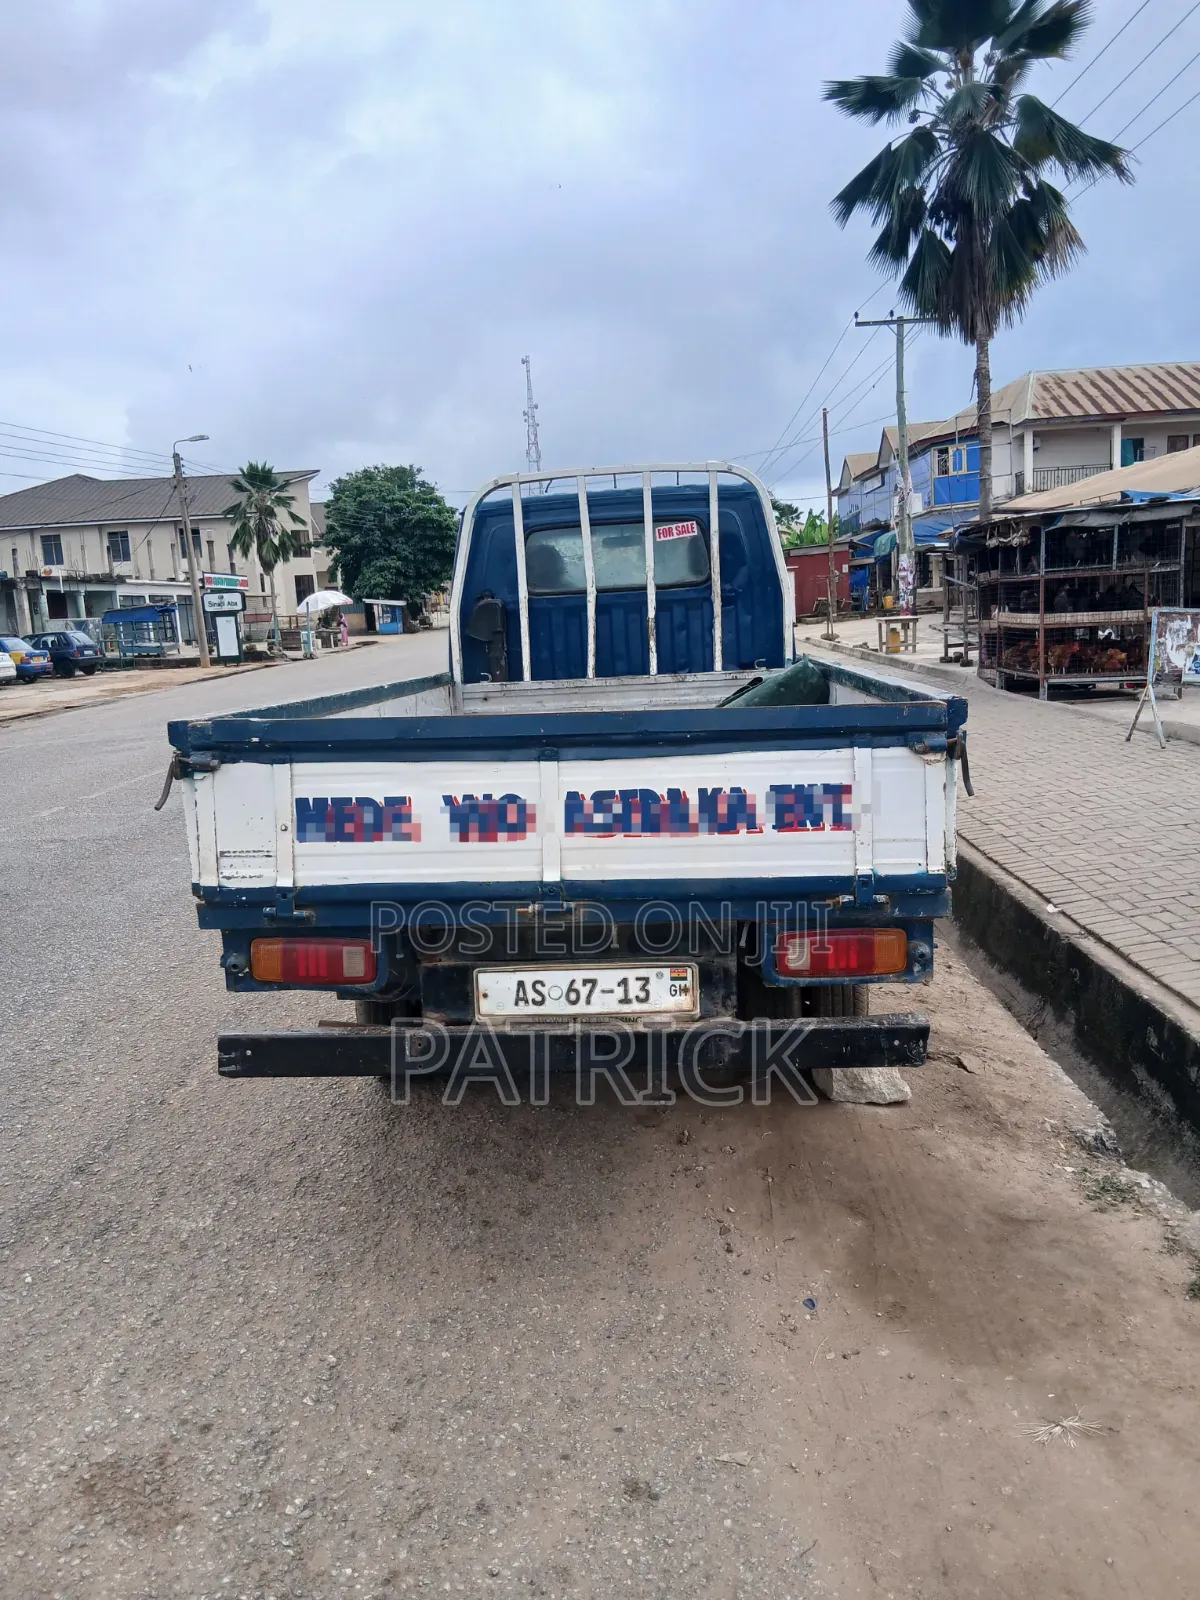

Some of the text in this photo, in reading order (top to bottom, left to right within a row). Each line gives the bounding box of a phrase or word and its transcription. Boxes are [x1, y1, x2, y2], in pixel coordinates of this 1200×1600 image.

[657, 523, 696, 539] FOR SALE
[514, 976, 651, 1007] AS 67-13
[669, 983, 690, 998] GH
